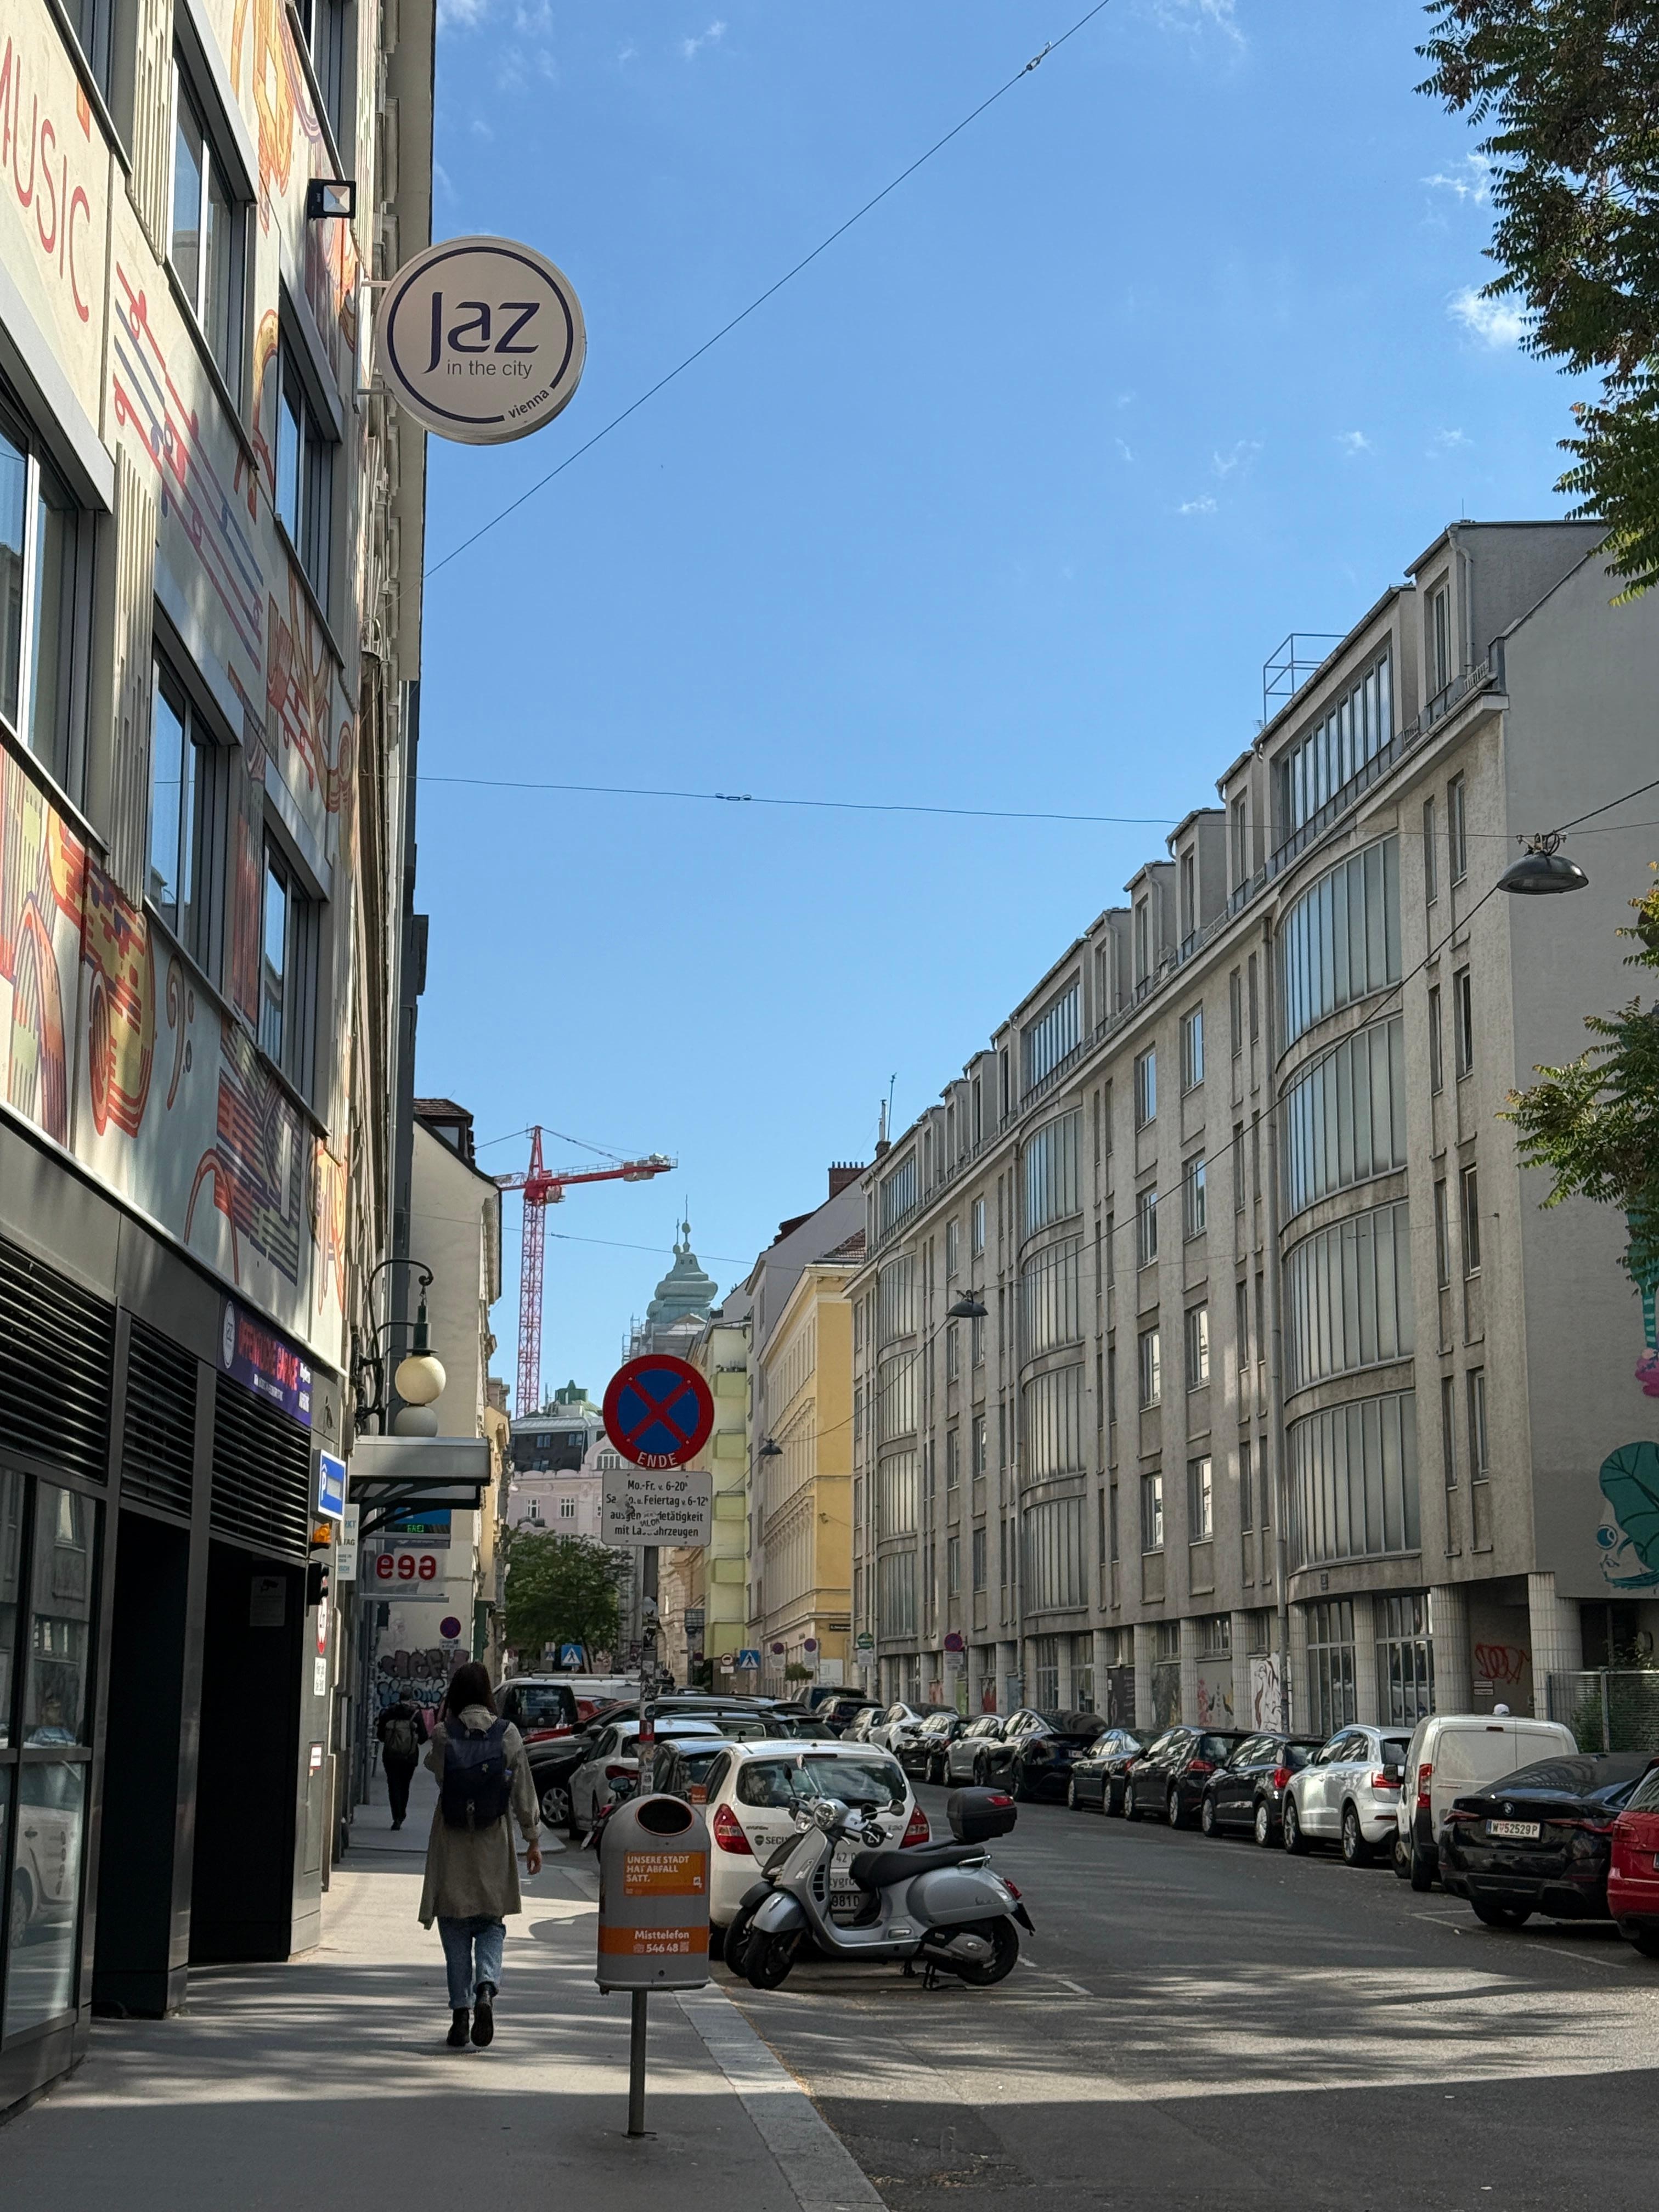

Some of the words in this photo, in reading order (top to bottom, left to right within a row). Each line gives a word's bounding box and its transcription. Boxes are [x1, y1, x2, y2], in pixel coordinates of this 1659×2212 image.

[447, 359, 462, 375] in
[469, 360, 496, 376] the
[503, 360, 532, 379] city
[508, 389, 550, 419] vienna
[637, 1452, 678, 1468] ENDE
[628, 1480, 656, 1491] Mo.-Fr.
[644, 1494, 680, 1508] Feiertag
[615, 1525, 629, 1535] mit
[1493, 1822, 1498, 1832] W
[627, 1855, 661, 1864] UNSERE
[663, 1855, 690, 1864] STADT
[626, 1865, 645, 1874] HAT
[646, 1865, 679, 1873] ABFALL
[626, 1874, 650, 1882] SATT.
[635, 1929, 690, 1940] Misttelefon
[646, 1943, 664, 1953] 546
[666, 1943, 679, 1952] 48
